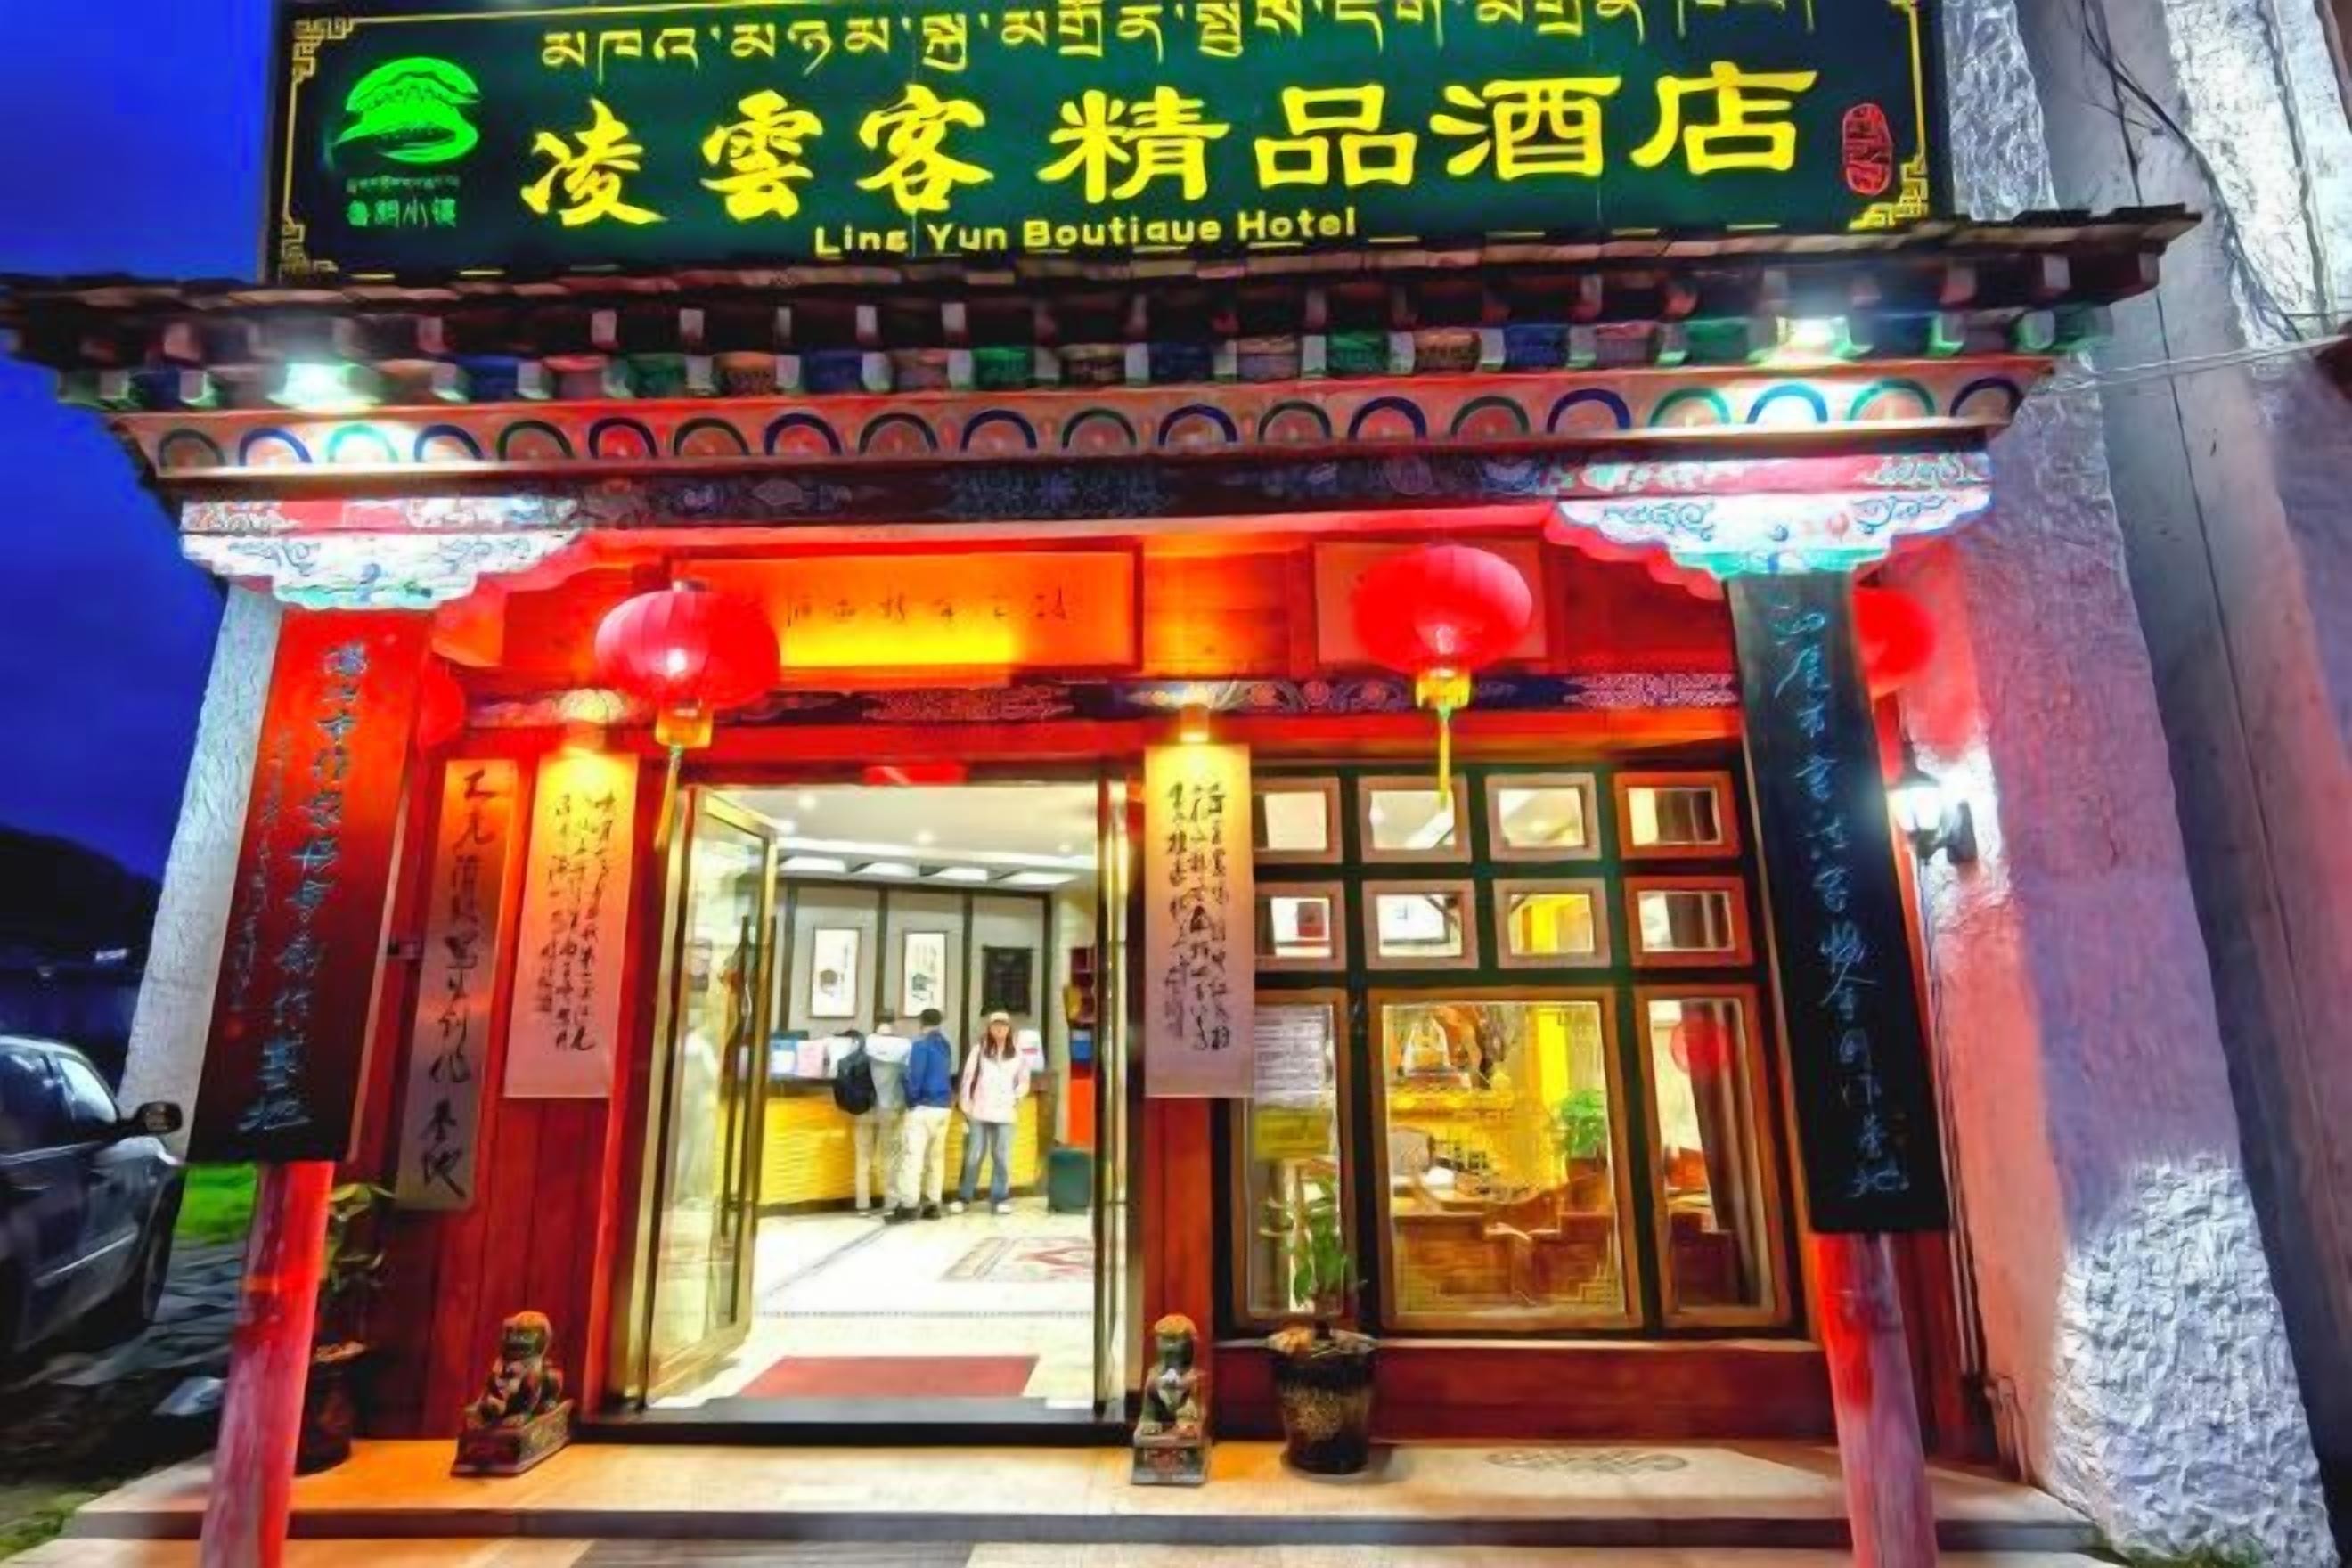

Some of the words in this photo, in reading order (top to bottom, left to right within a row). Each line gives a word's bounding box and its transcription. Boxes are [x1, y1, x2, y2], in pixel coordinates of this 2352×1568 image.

[521, 61, 1817, 227] 凌雲客精品酒店
[925, 222, 1007, 251] Yun
[1022, 216, 1222, 248] Boutique
[1237, 206, 1356, 240] Hotel
